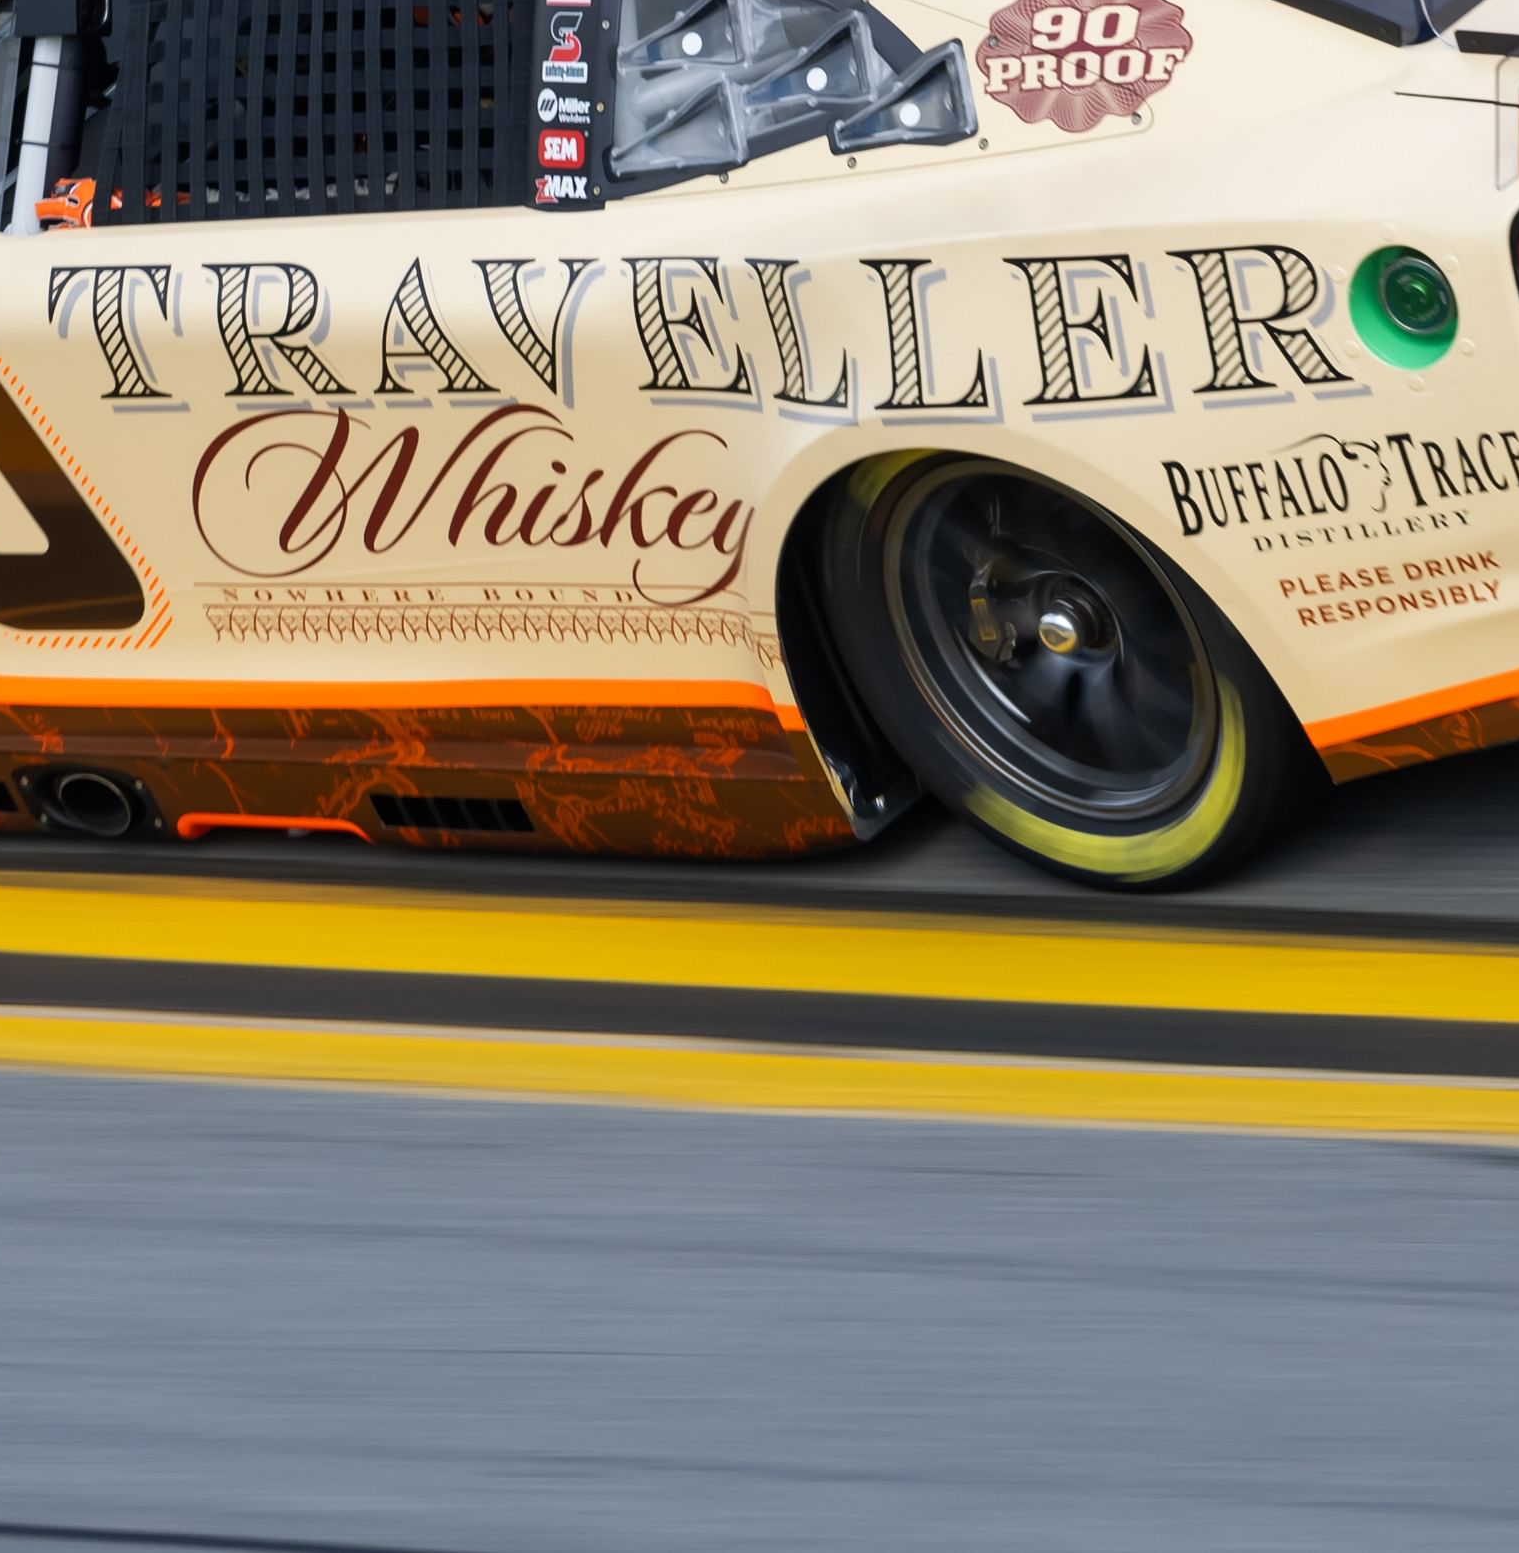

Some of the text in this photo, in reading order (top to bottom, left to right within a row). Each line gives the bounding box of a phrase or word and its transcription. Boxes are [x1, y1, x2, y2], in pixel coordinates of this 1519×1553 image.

[1032, 4, 1141, 51] 90
[984, 47, 1186, 94] PROOF
[558, 97, 591, 114] Miller
[543, 136, 578, 162] SEM
[48, 242, 1366, 422] TRAVELLER
[192, 403, 757, 608] Whiskey
[1160, 452, 1350, 537] BUFFALO
[1251, 507, 1473, 553] DISTILLERY
[220, 588, 636, 605] NOWHERE BOUND
[1277, 549, 1502, 600] PLEASE DRINK
[1295, 579, 1502, 629] RESPONSIBLY
